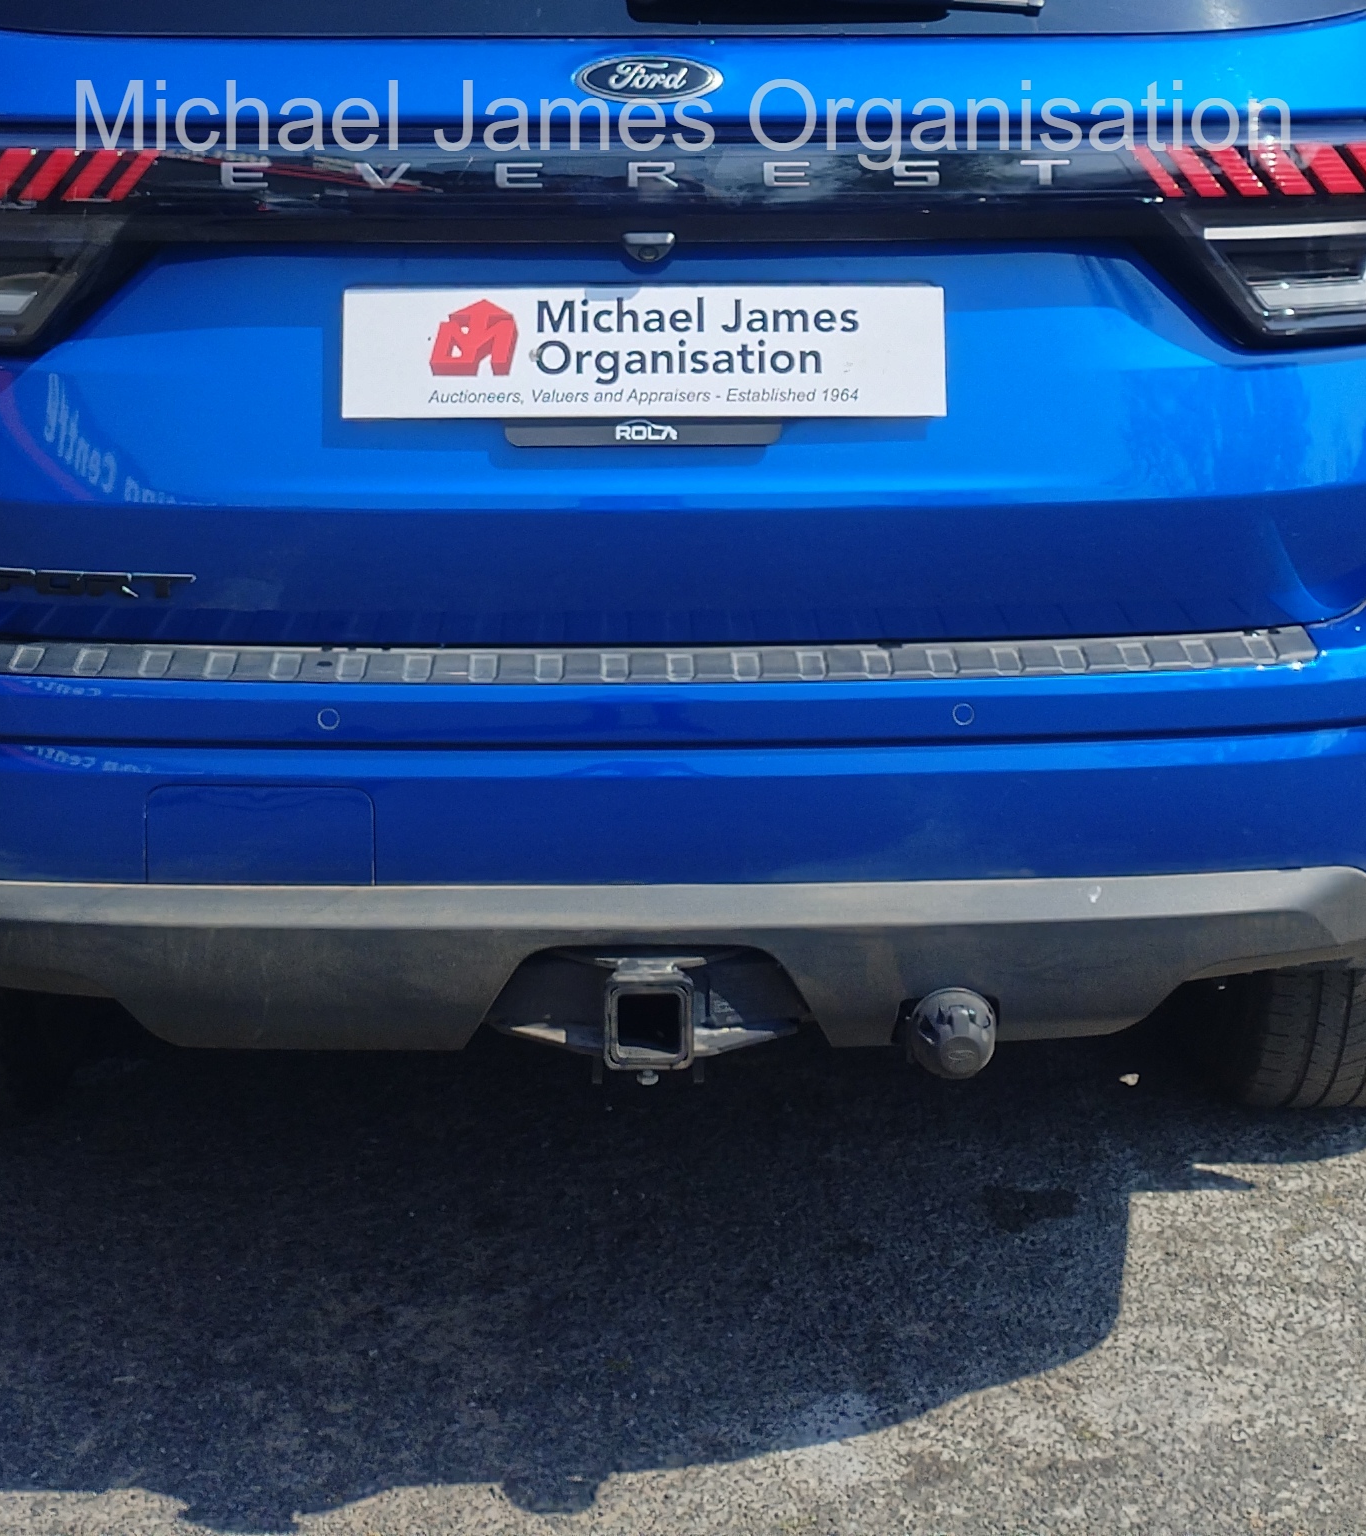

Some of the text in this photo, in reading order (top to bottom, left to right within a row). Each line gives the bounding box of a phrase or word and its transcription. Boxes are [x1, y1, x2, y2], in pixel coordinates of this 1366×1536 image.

[608, 62, 688, 91] Ford
[220, 158, 1071, 189] EVEREST
[536, 296, 859, 333] Michael James
[533, 338, 822, 385] Organisation
[427, 389, 524, 405] Auctioneers,
[531, 388, 590, 404] Valuers
[593, 388, 625, 403] and
[626, 388, 711, 406] Appraisers
[725, 387, 817, 403] Established
[822, 387, 859, 403] 1964
[615, 424, 678, 440] ROLA
